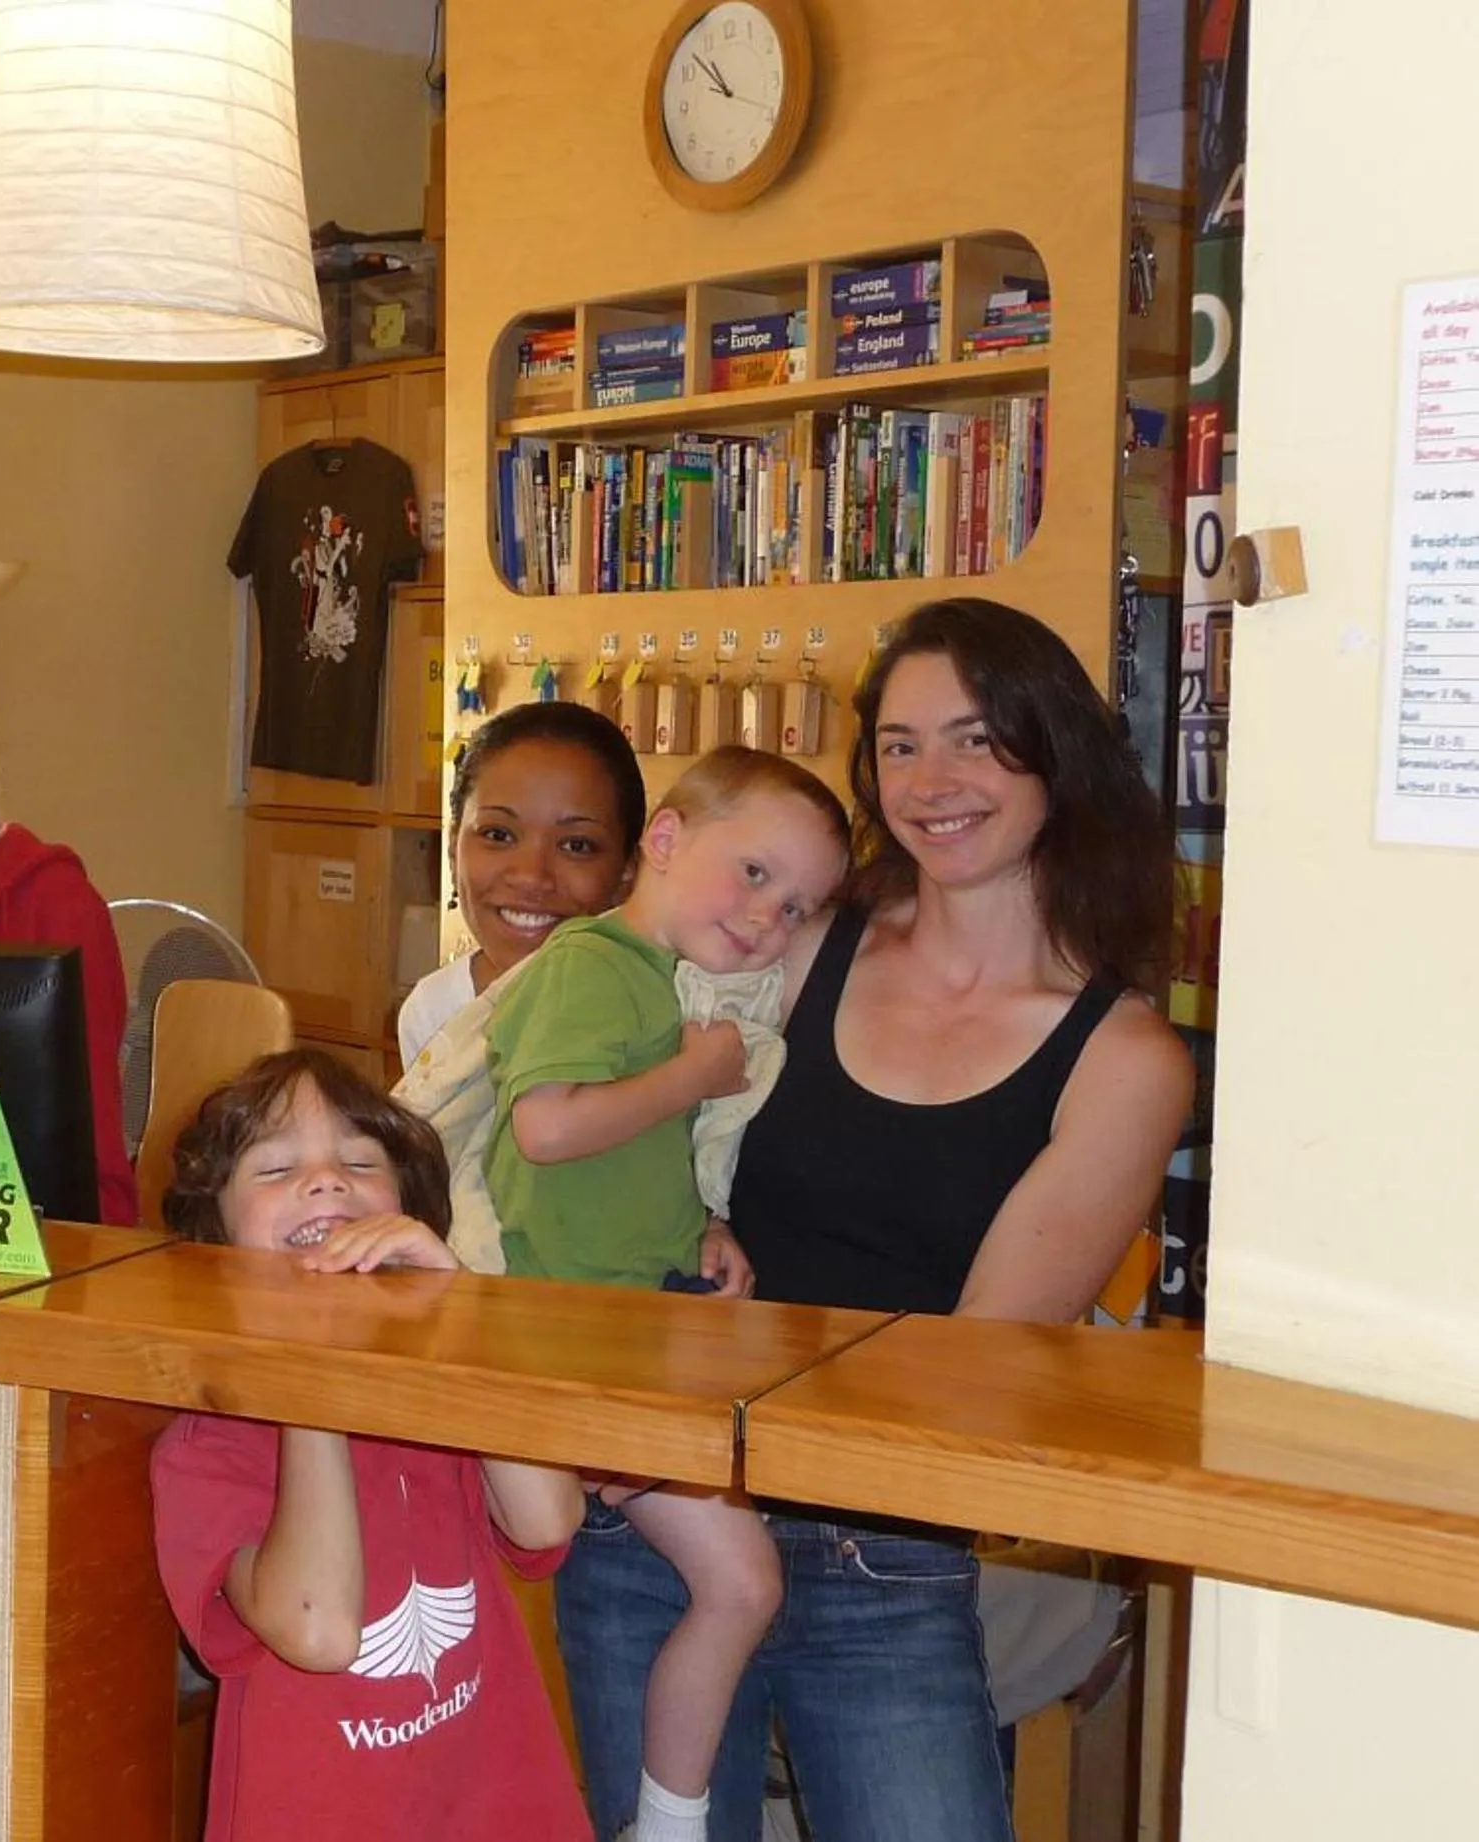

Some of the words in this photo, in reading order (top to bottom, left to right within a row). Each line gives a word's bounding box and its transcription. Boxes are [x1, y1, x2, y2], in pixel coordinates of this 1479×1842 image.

[724, 20, 736, 39] 12
[703, 33, 714, 51] 11
[682, 63, 695, 83] 10
[680, 101, 689, 116] 9
[849, 277, 890, 294] europe
[864, 308, 903, 329] Poland
[730, 333, 772, 351] Europe
[857, 332, 905, 354] England
[825, 462, 841, 532] Germany
[642, 634, 656, 649] 34
[764, 629, 780, 645] 37
[808, 628, 824, 644] 38
